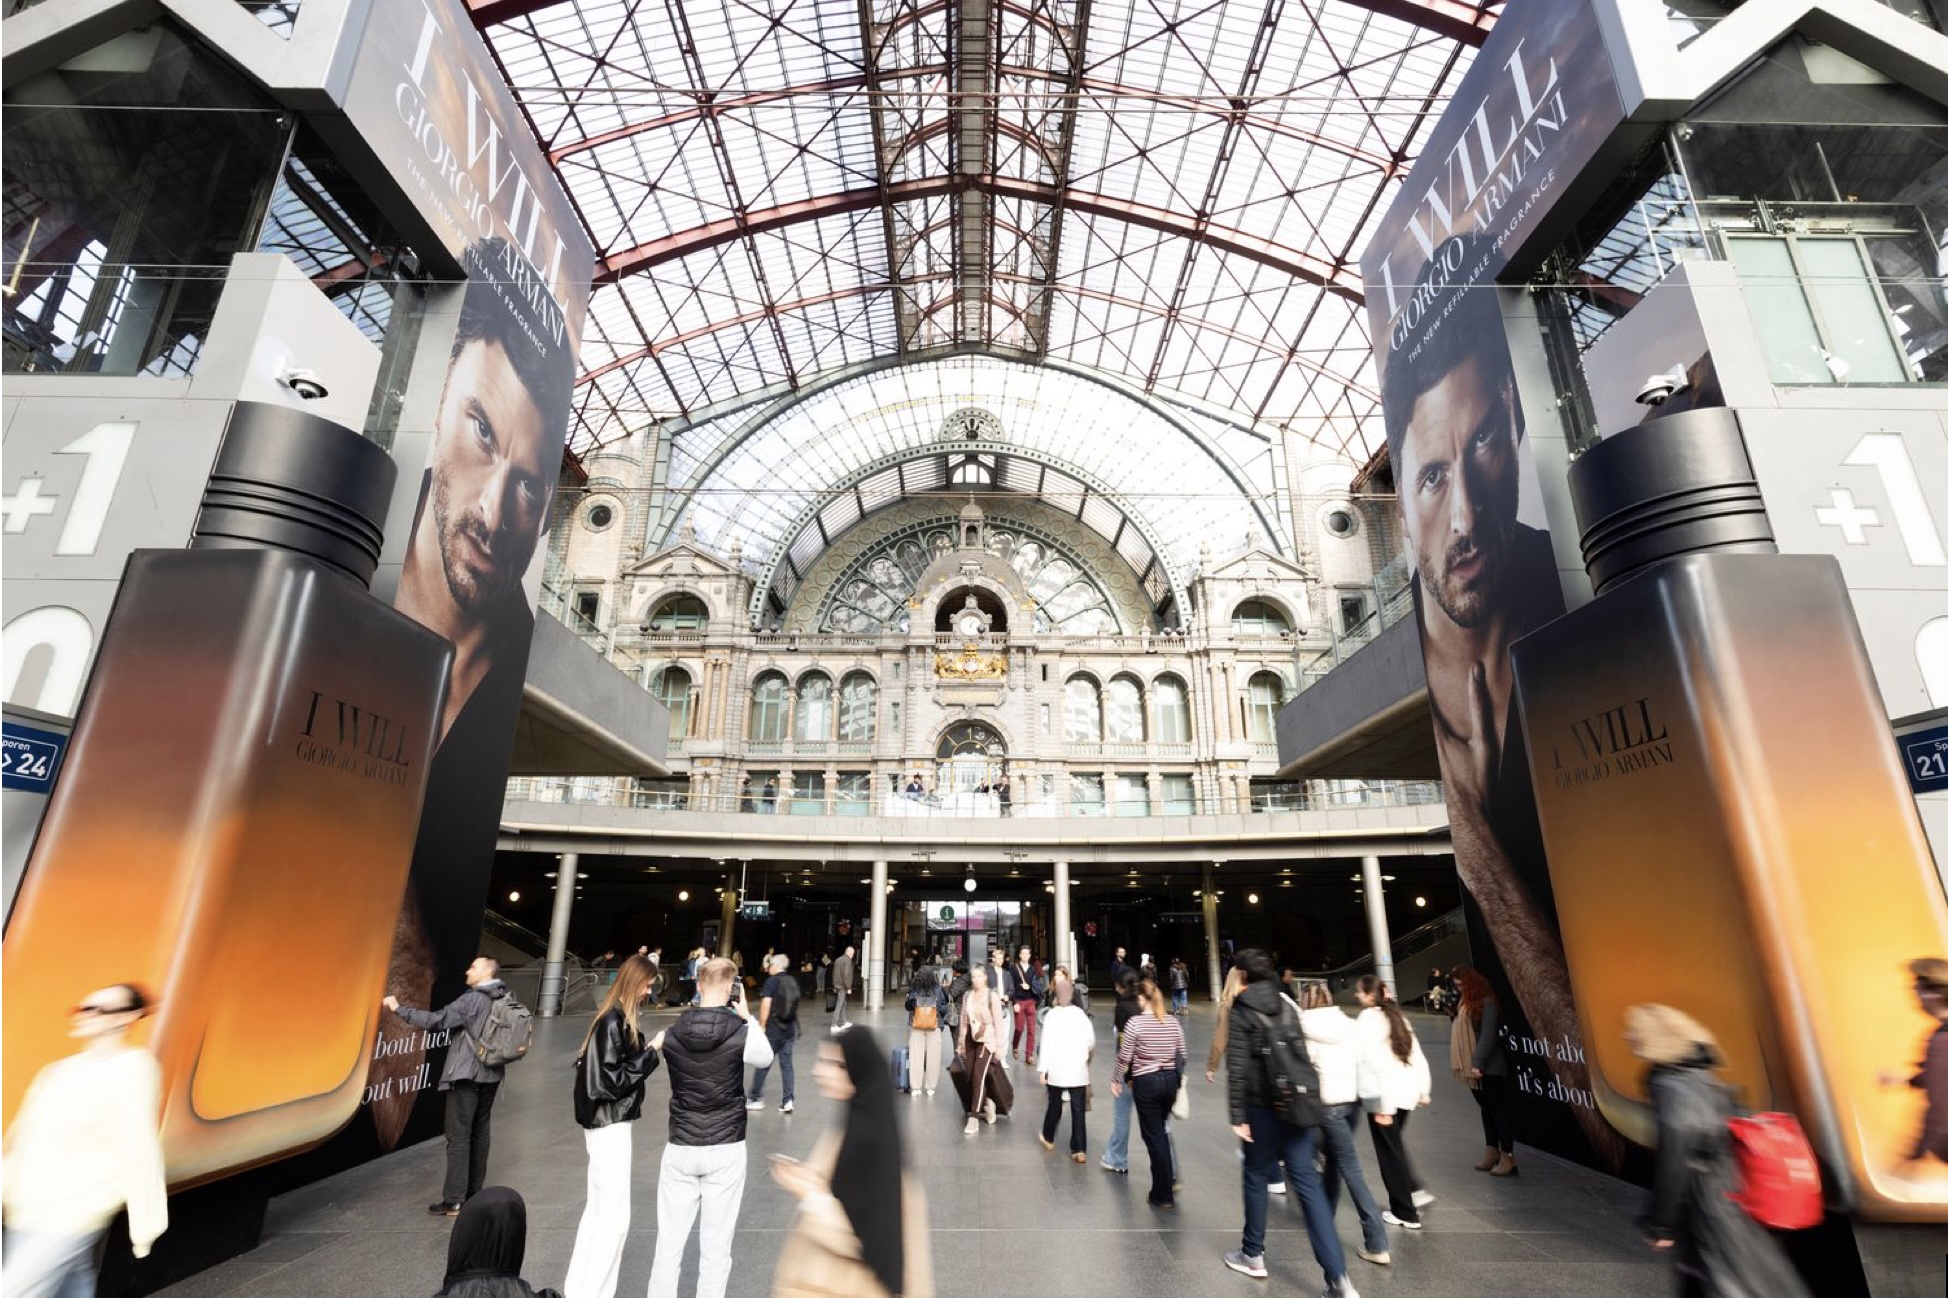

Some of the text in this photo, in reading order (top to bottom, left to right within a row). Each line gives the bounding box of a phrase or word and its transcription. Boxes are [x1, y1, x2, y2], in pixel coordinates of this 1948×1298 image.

[404, 0, 569, 319] I WILL
[1379, 37, 1559, 324] I WILL
[395, 82, 565, 349] GIORGIO ARMANI
[1391, 87, 1568, 351] GIORGIO ARMANI
[406, 155, 427, 189] THE
[503, 295, 548, 358] FRAGRANCE
[1408, 167, 1556, 364] THE NEW REFILLABLE FRAGRANCE
[300, 690, 410, 767] I WILL
[1570, 697, 1668, 759] WILL
[1614, 742, 1674, 775] ARMANI
[15, 752, 47, 777] 24
[1916, 752, 1946, 777] 21
[399, 1062, 431, 1095] will.
[1516, 1065, 1543, 1096] it's
[1521, 1036, 1552, 1059] not
